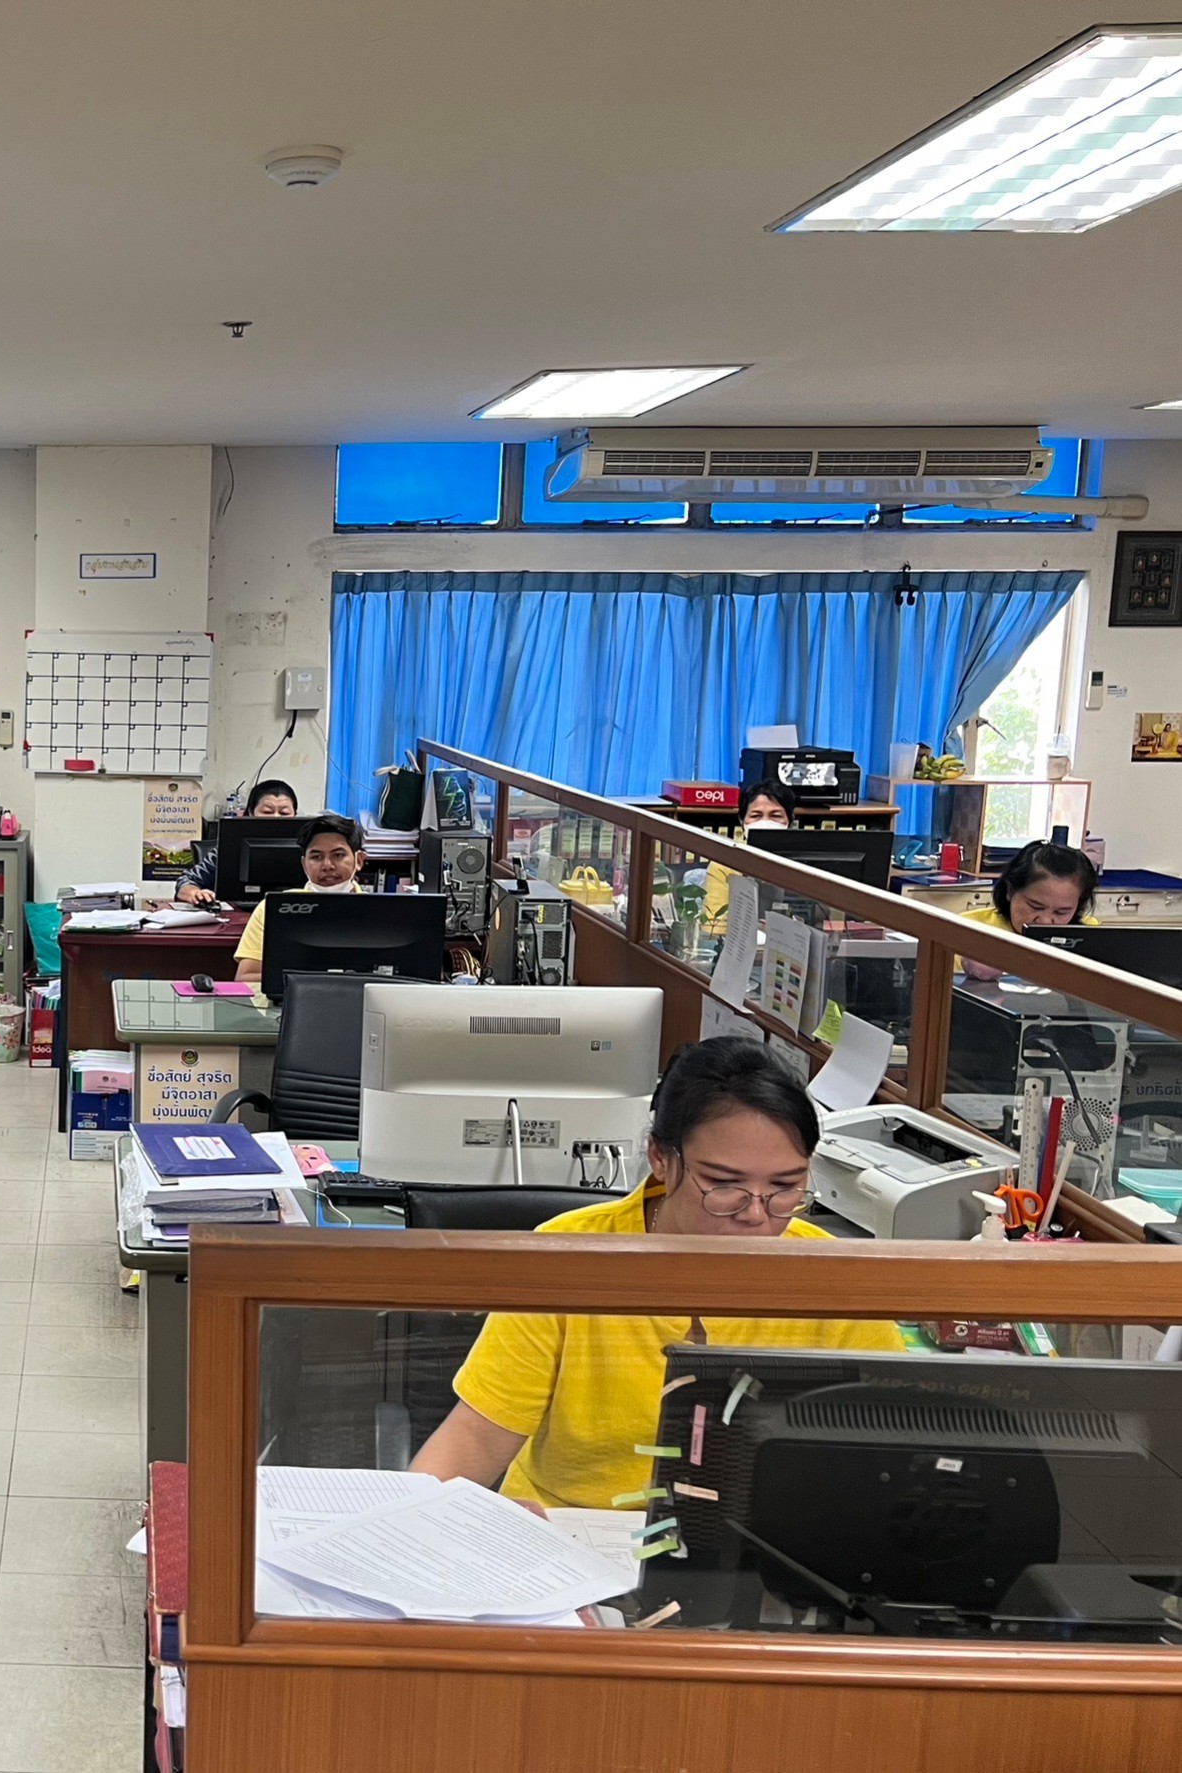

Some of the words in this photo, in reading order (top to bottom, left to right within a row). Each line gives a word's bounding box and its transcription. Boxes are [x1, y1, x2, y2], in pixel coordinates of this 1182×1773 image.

[279, 903, 319, 914] acer
[148, 1065, 192, 1082] ซื่อสัตย์
[197, 1070, 232, 1087] สุจริต
[162, 1086, 218, 1100] มีจิตอาสา
[153, 1101, 213, 1120] มุ่งมั่นพัฒ
